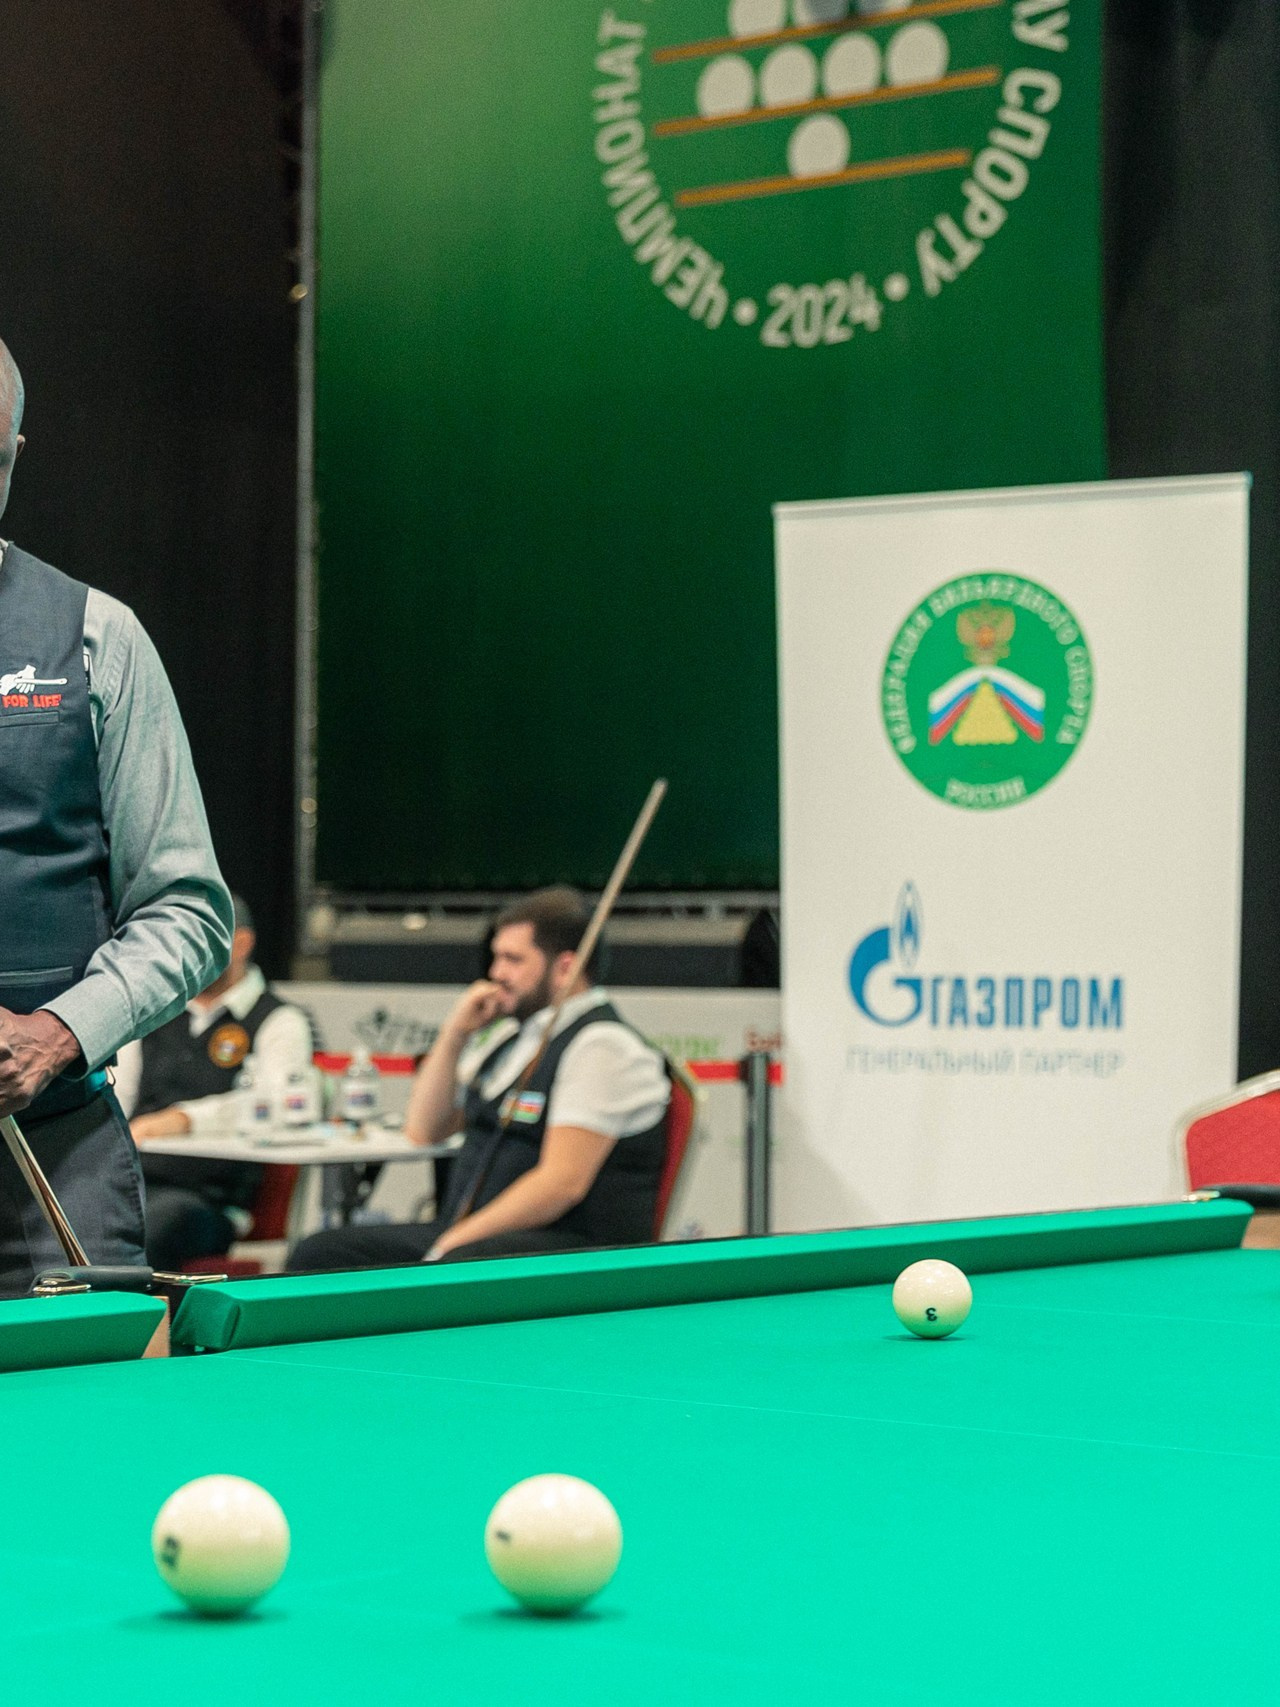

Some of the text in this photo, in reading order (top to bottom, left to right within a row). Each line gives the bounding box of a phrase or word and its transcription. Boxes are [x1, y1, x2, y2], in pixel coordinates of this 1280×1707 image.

[593, 9, 729, 329] ЧЕМПИОНАТ
[915, 67, 1061, 297] СПОРТУ
[760, 272, 883, 348] 2024
[2, 694, 29, 708] FOR
[930, 977, 1124, 1030] ГАЗПРОМ
[925, 1307, 938, 1322] 3
